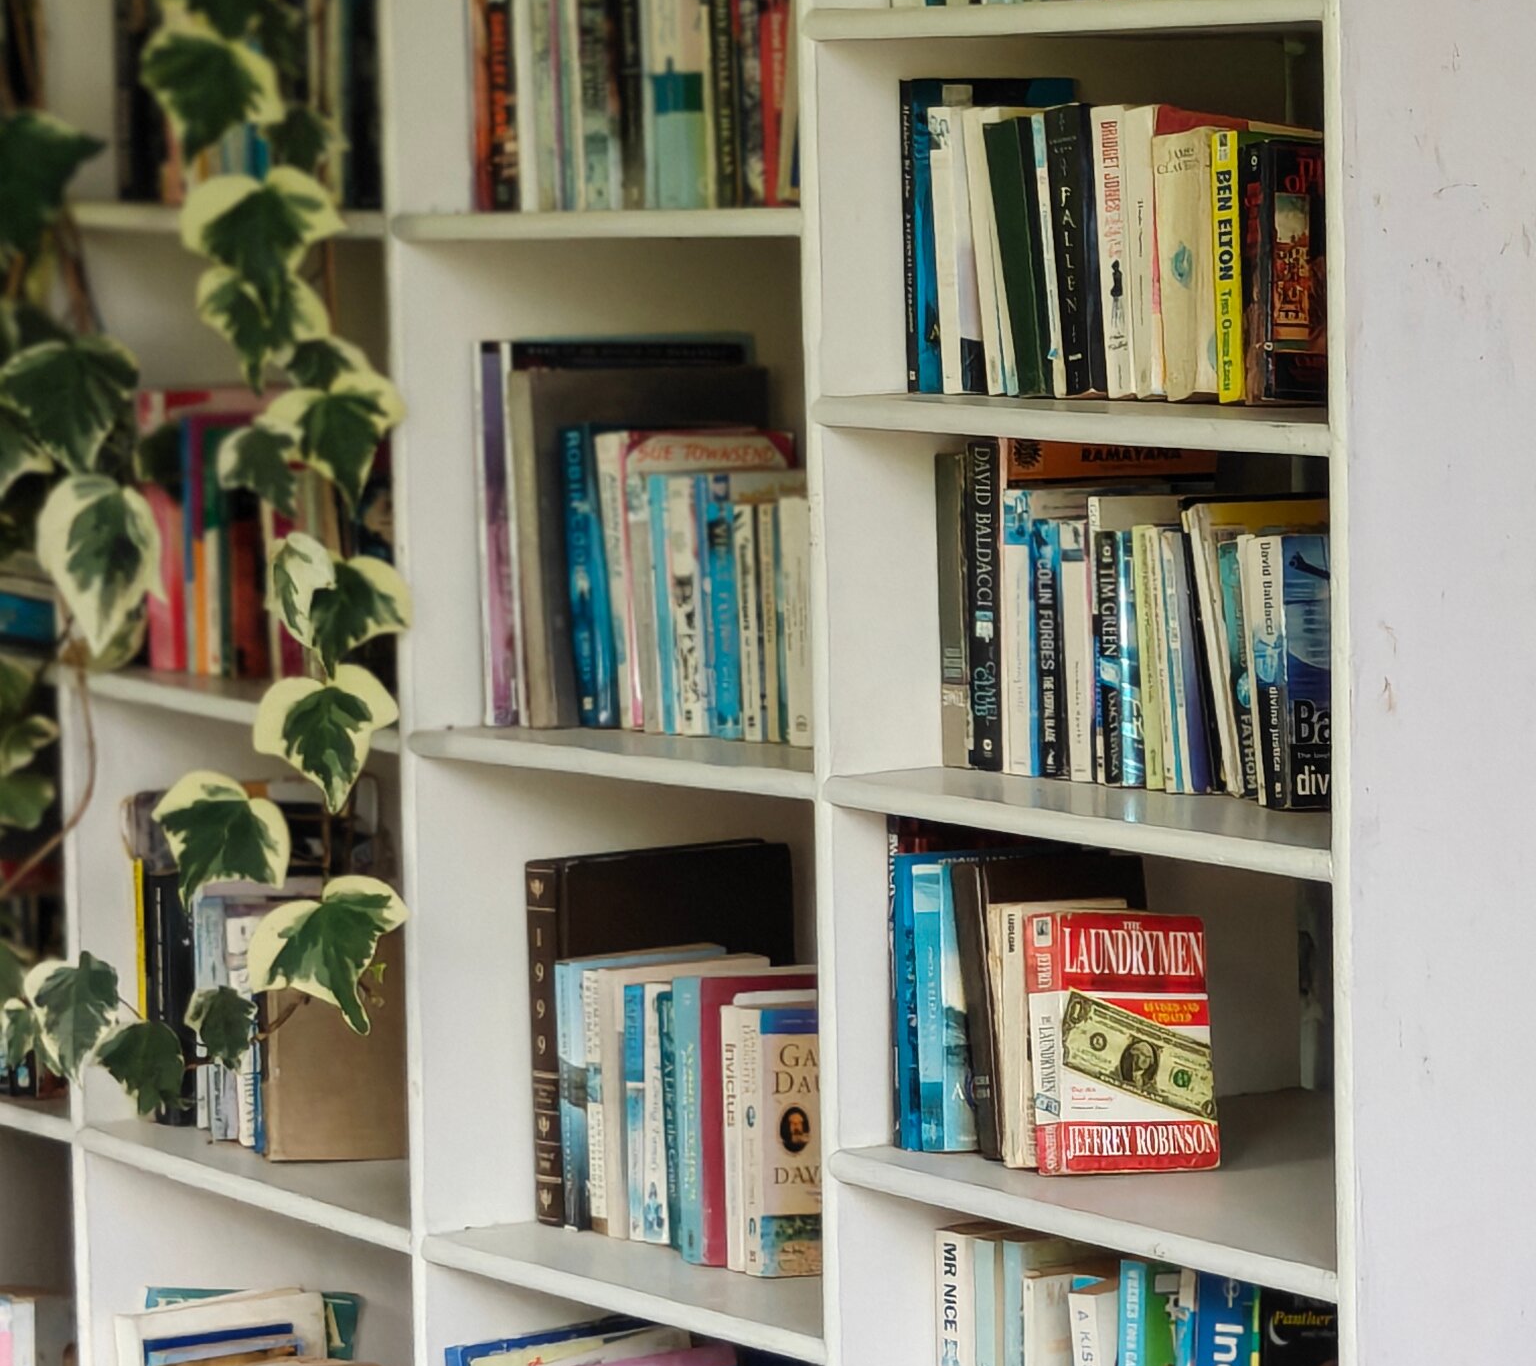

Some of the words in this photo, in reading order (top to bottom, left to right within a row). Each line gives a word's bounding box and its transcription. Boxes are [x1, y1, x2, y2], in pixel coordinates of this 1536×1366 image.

[1100, 120, 1120, 170] BRIDGET
[1103, 173, 1121, 213] JONES
[1215, 169, 1233, 212] BEN
[1059, 185, 1079, 314] FALLEN
[1217, 218, 1235, 282] ELTON
[566, 430, 585, 510] ROBIN
[635, 444, 673, 463] SUE
[683, 442, 776, 463] TOWNSEND
[974, 446, 993, 506] DAVID
[1080, 446, 1182, 463] RAMAYANA
[975, 512, 994, 607] BALDACCI
[1036, 558, 1053, 605] COLIN
[1099, 565, 1116, 598] TIM
[1259, 542, 1272, 577] David
[1101, 603, 1118, 659] GREEN
[1262, 580, 1275, 636] Baldacci
[1038, 609, 1055, 671] FORBES
[973, 666, 988, 716] CLUB
[984, 660, 997, 726] CAMEL
[1043, 676, 1055, 690] THE
[1267, 685, 1281, 726] divine
[1240, 714, 1257, 790] FATHOM
[1268, 728, 1282, 772] justice
[1296, 764, 1330, 796] div
[1122, 921, 1143, 930] THE
[1062, 927, 1205, 977] LAUNDRYMEN
[534, 927, 547, 1056] 1999
[664, 1060, 674, 1074] A
[779, 1043, 817, 1068] GA
[1038, 1026, 1056, 1094] LAUNDRYMEN
[724, 1043, 737, 1128] Invictus
[1066, 1125, 1133, 1159] JEFFREY
[1135, 1124, 1218, 1157] ROBINSON
[942, 1242, 958, 1276] MR
[943, 1283, 959, 1333] NICE
[1077, 1309, 1089, 1322] A
[1274, 1310, 1333, 1327] Panther
